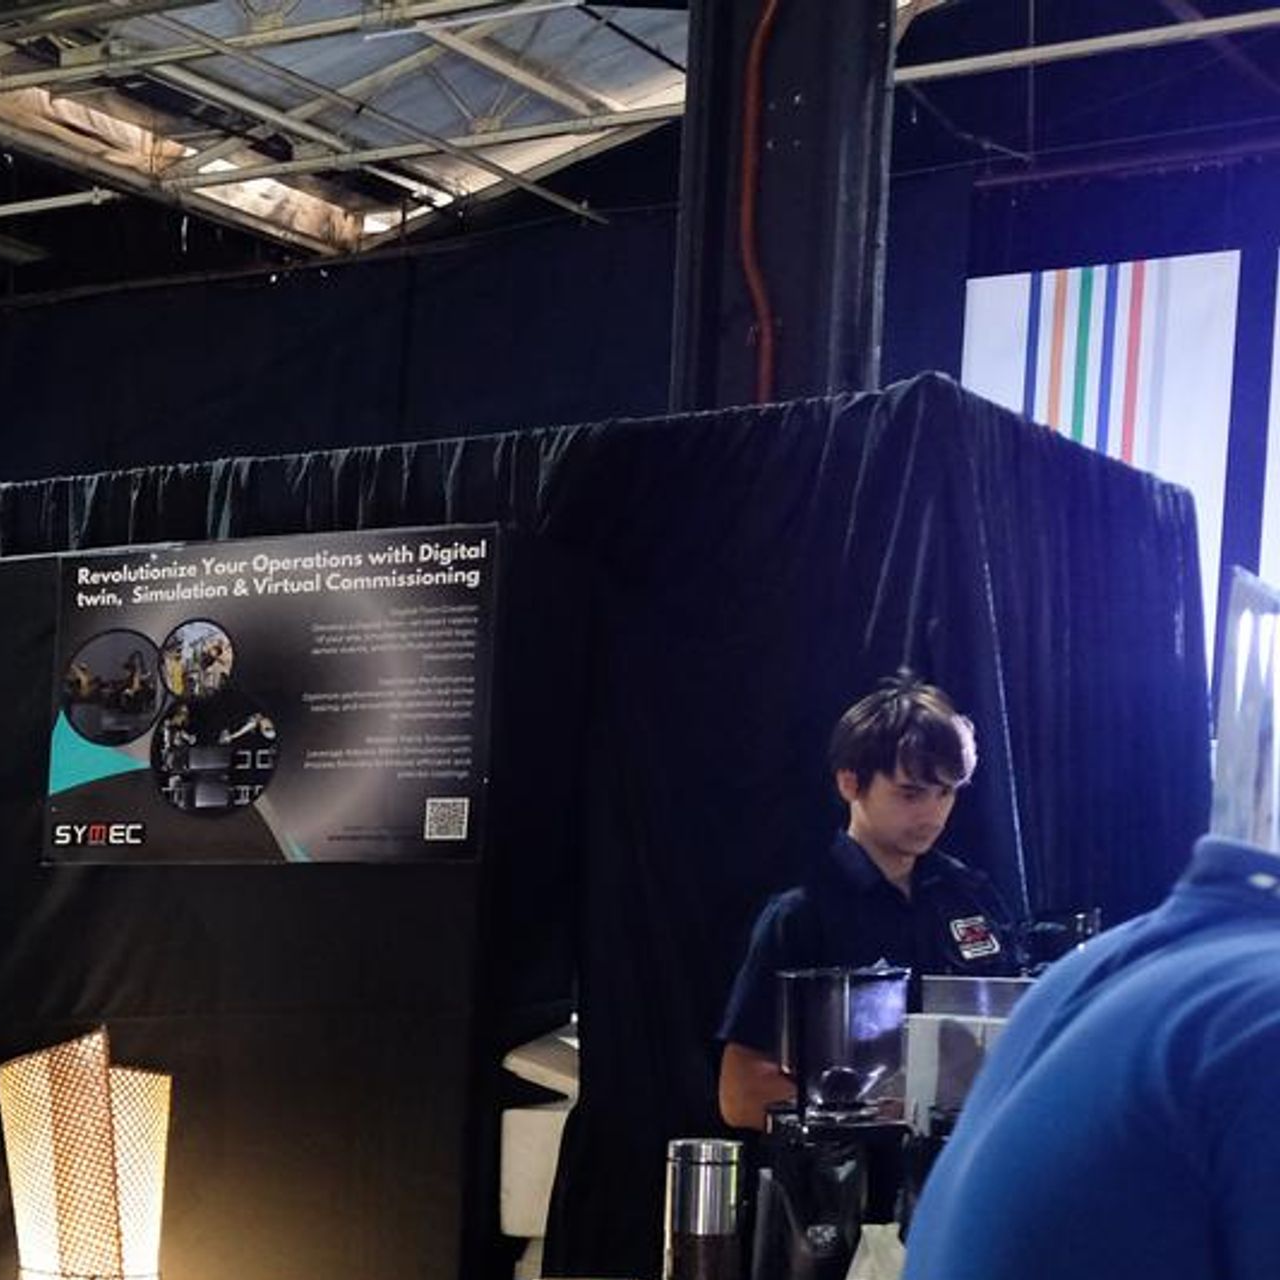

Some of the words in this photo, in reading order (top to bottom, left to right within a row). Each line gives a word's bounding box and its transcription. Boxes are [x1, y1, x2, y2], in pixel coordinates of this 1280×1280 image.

[77, 565, 197, 586] Revolutionize
[202, 558, 248, 577] Your
[252, 551, 363, 577] Operations
[367, 546, 414, 566] with
[419, 540, 488, 567] Digital
[77, 588, 123, 609] twin,
[132, 580, 228, 605] Simulation
[233, 579, 250, 598] &
[253, 571, 321, 595] Virtual
[326, 566, 481, 592] Commissioning
[54, 823, 143, 845] SYMEC
